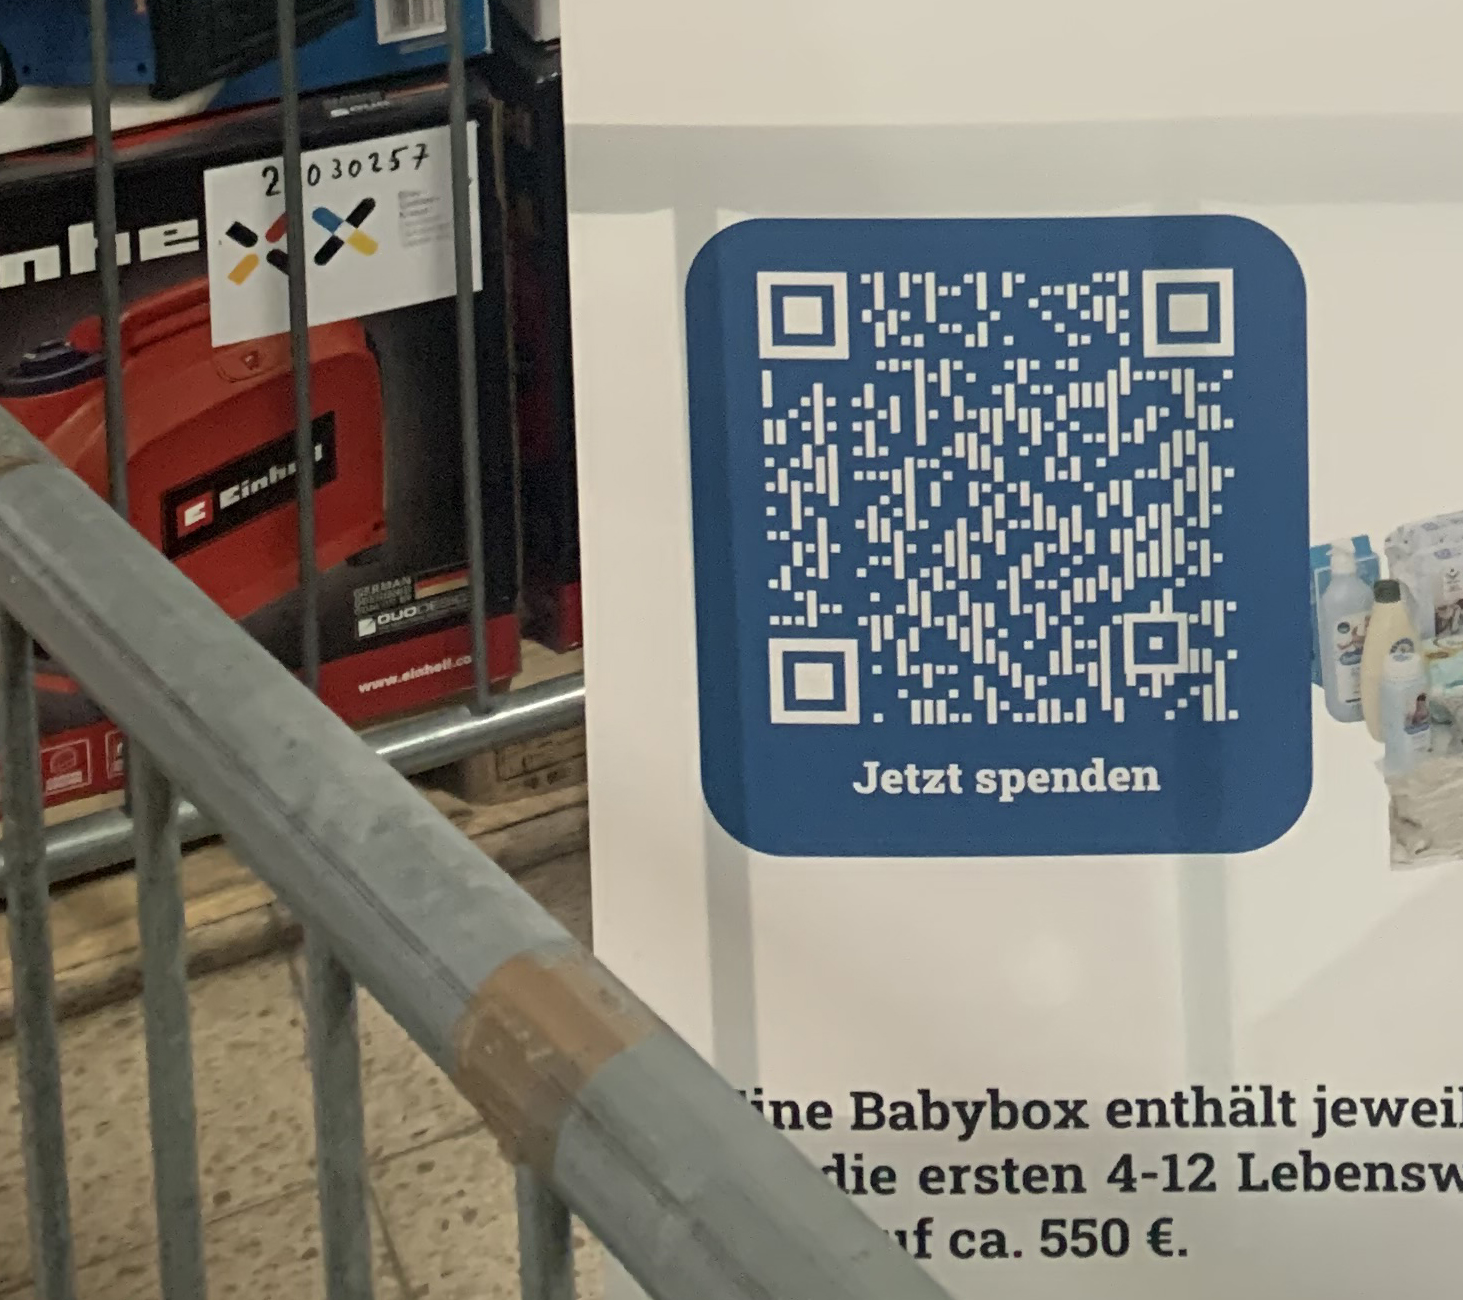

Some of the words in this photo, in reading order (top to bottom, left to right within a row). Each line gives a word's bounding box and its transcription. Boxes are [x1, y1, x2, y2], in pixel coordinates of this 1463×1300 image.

[261, 143, 430, 197] 2030257
[853, 762, 962, 794] Jetzt
[976, 758, 1160, 802] spenden
[737, 1087, 833, 1130] ne
[850, 1088, 1089, 1142] Babybox
[1106, 1085, 1296, 1129] enthält
[919, 1158, 1087, 1195] ersten
[1107, 1153, 1216, 1193] 4-12
[949, 1229, 1022, 1259] ca.
[1040, 1218, 1129, 1258] 550
[1146, 1217, 1187, 1257] €.
